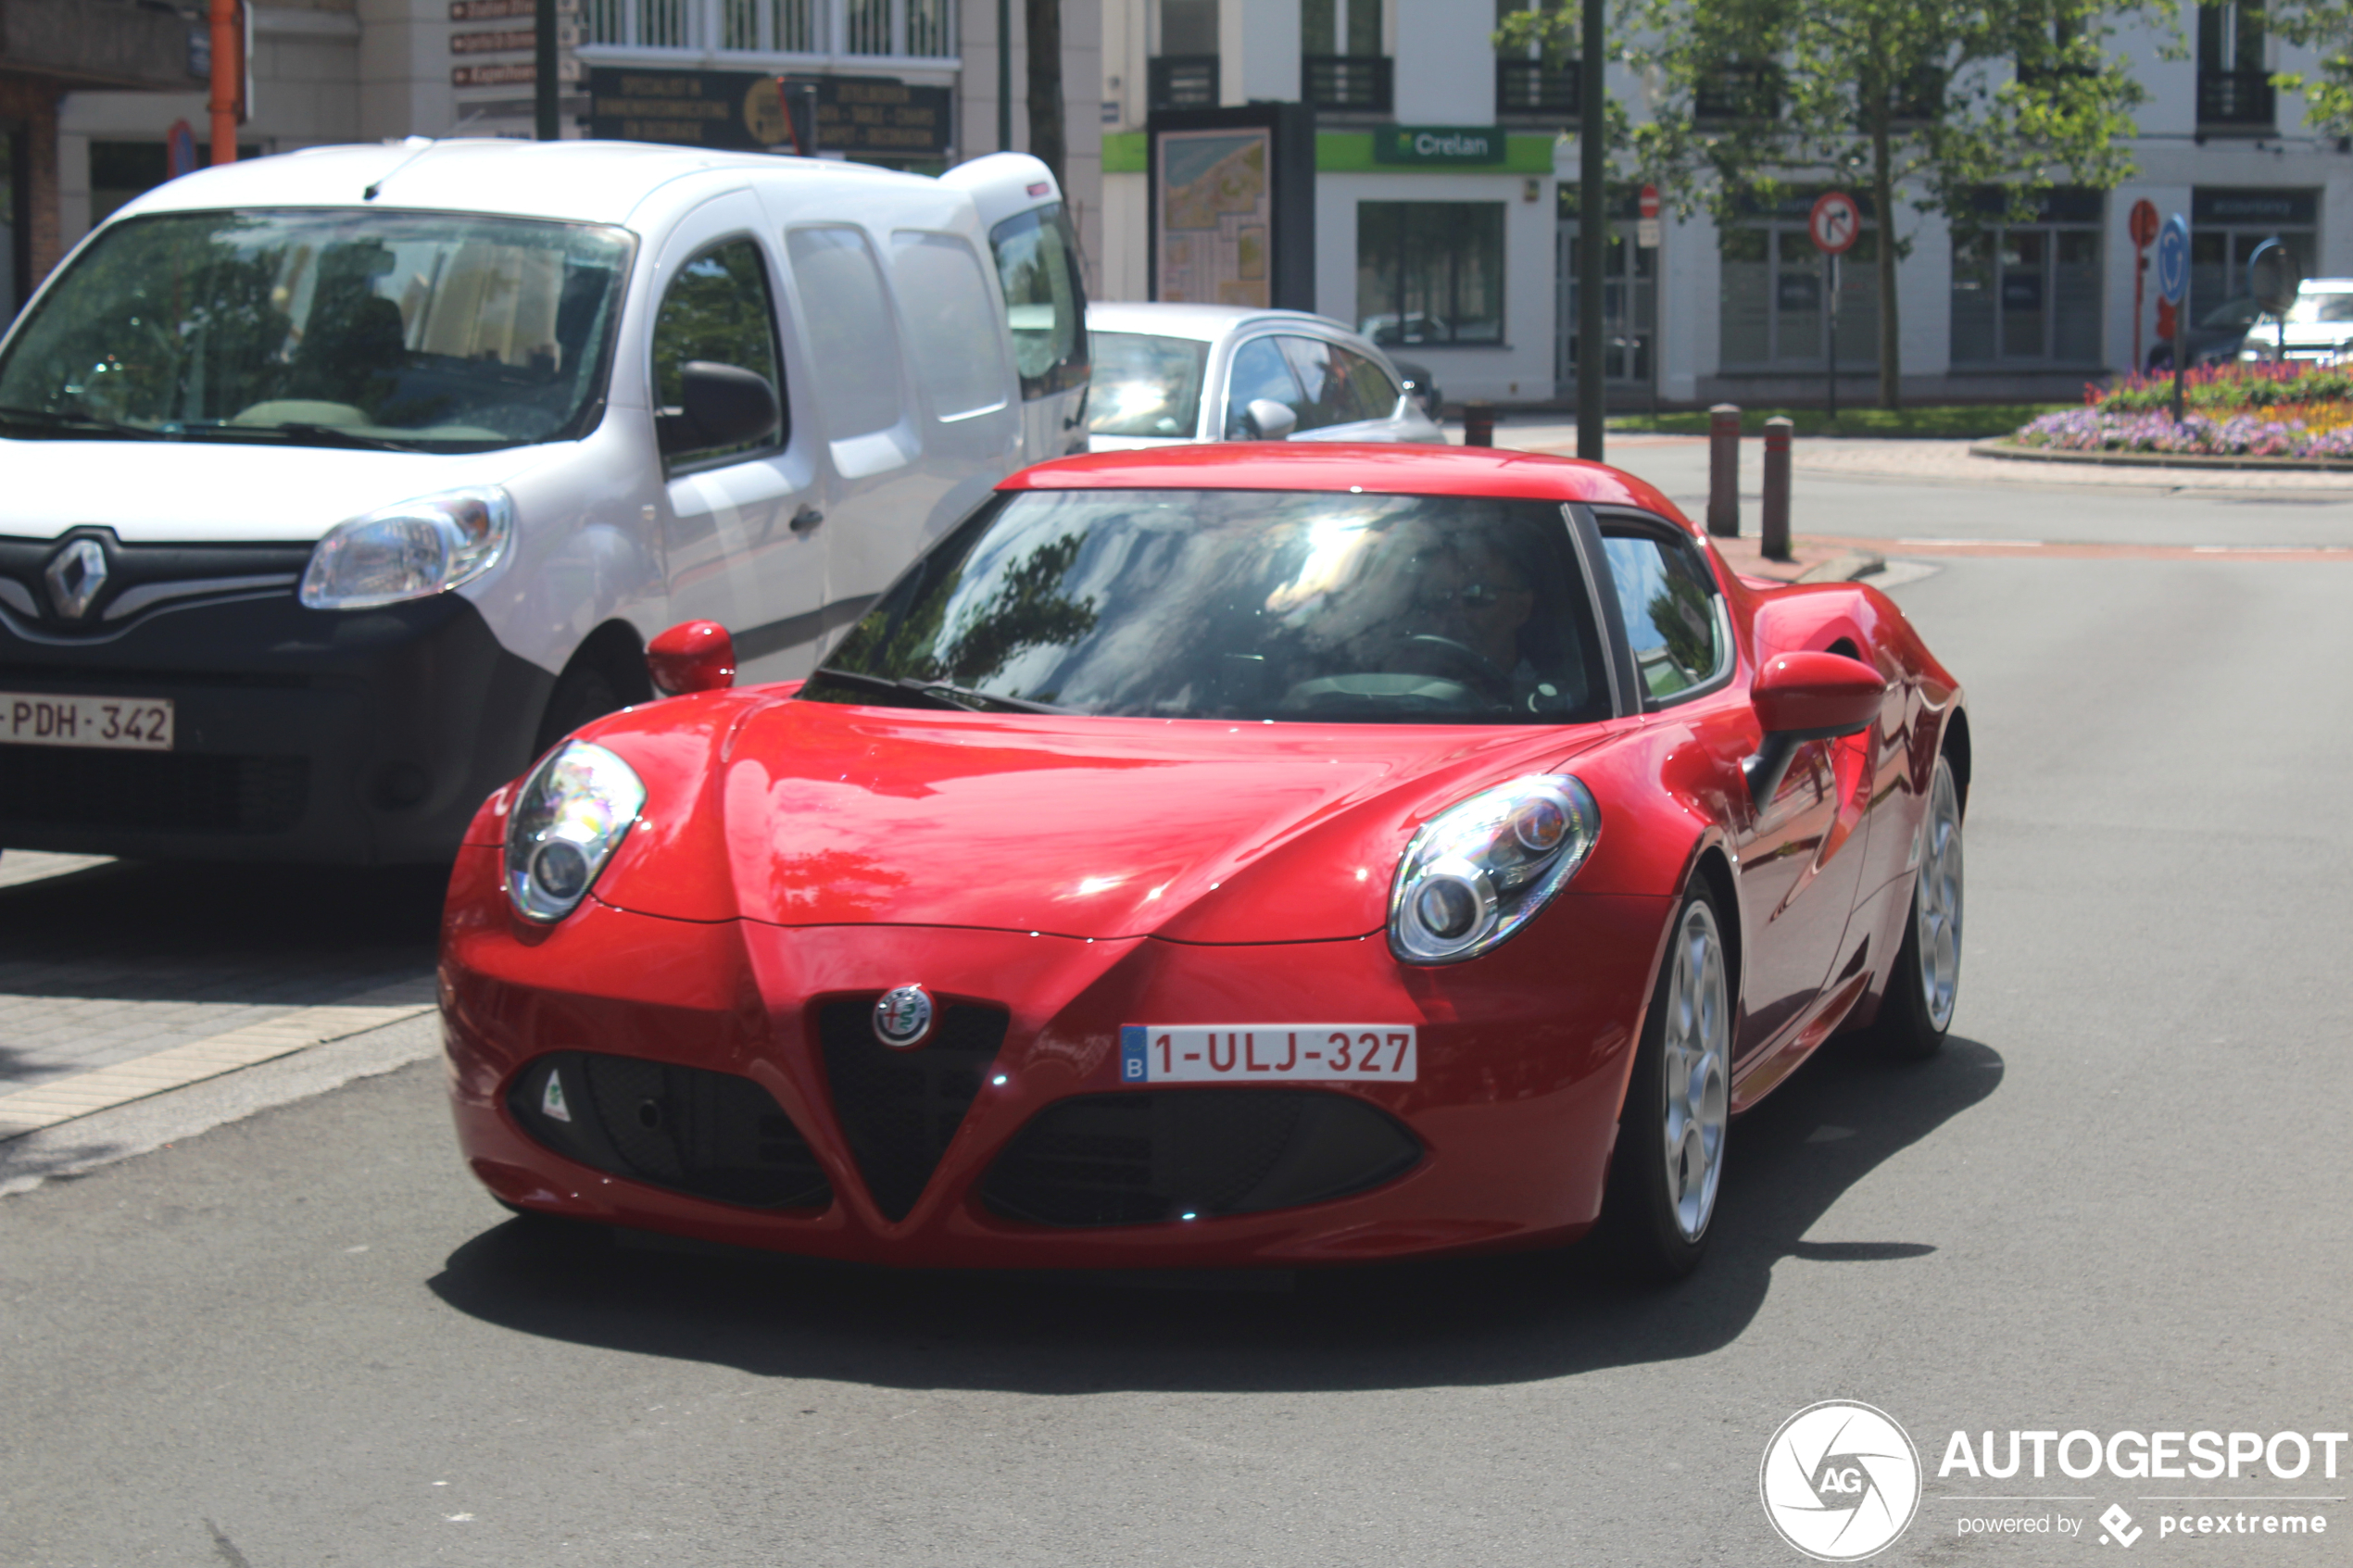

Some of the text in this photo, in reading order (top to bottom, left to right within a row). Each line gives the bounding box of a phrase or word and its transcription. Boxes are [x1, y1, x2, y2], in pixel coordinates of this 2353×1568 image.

[1415, 132, 1489, 156] Crelan
[1155, 1032, 1411, 1073] 1-ULJ-327
[1126, 1058, 1144, 1078] B
